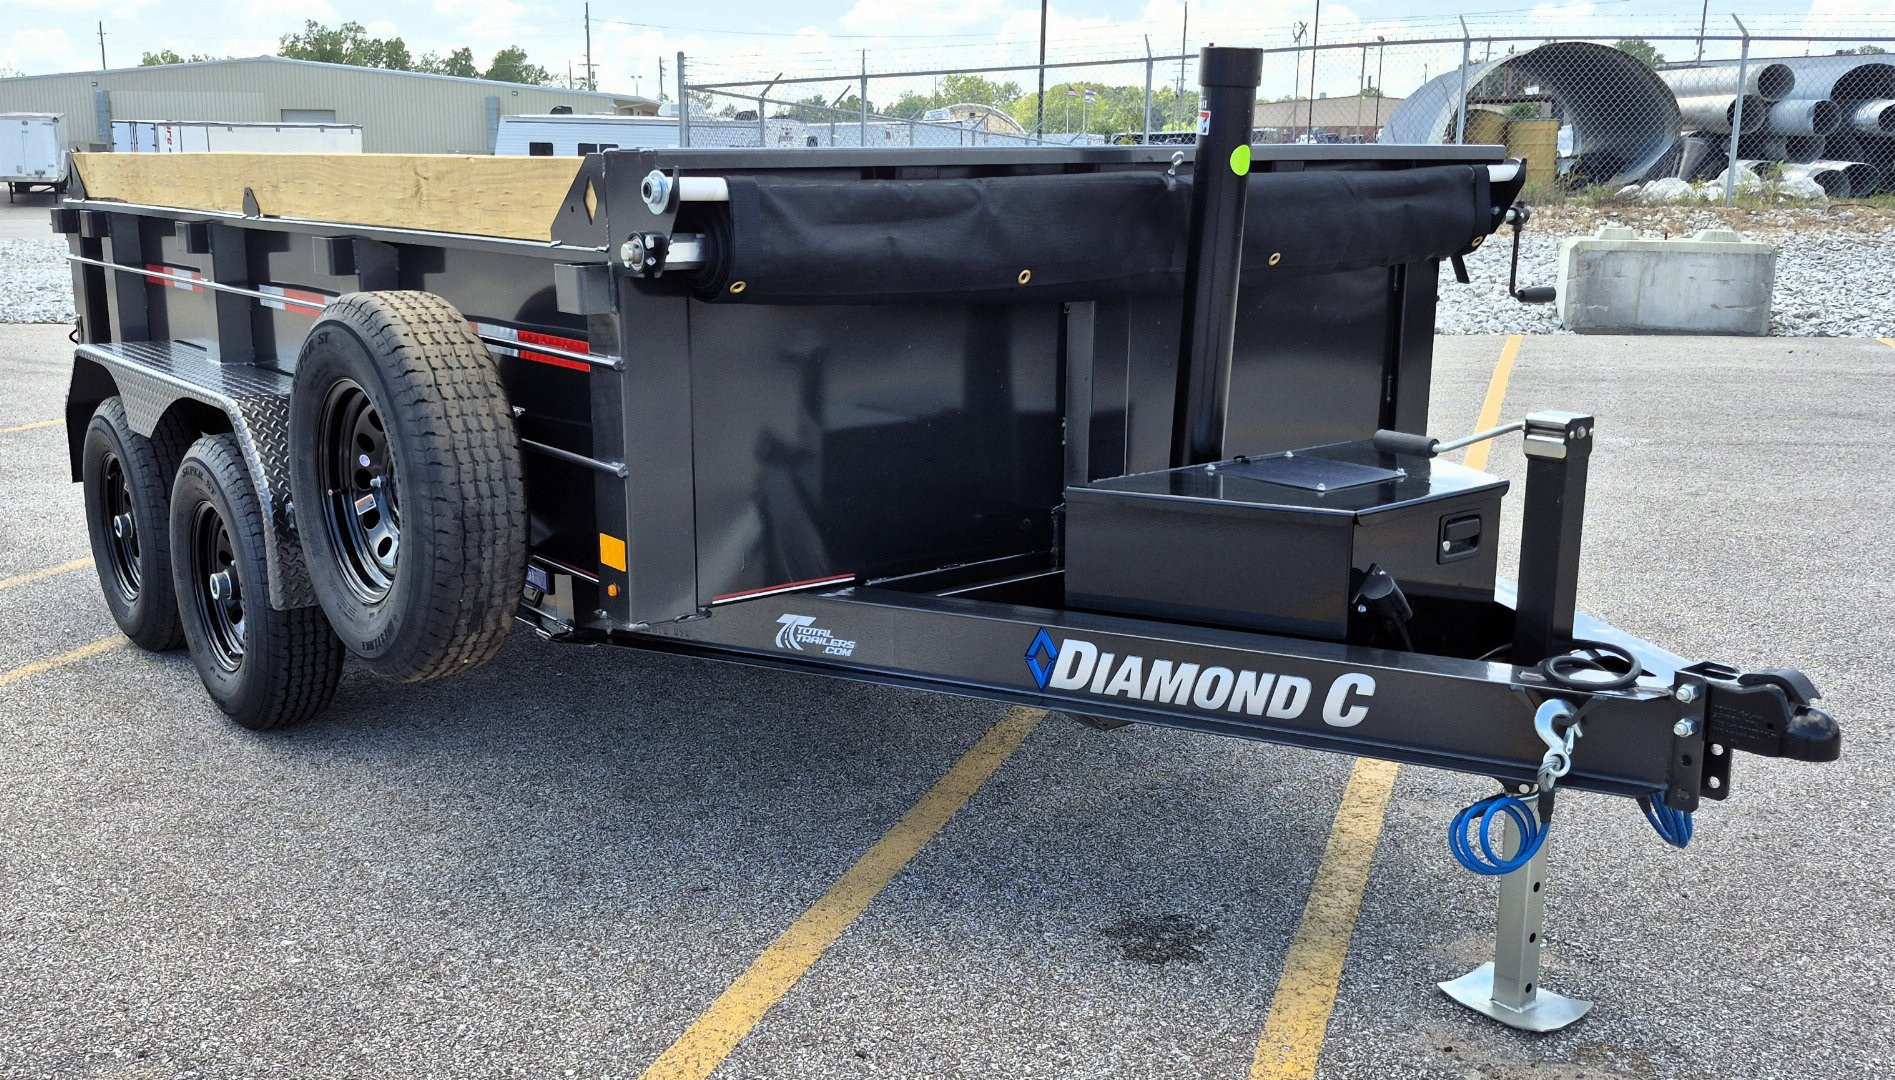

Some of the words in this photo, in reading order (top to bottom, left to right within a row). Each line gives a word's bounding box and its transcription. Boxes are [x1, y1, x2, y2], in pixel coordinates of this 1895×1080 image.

[797, 626, 834, 638] TOTAL
[796, 634, 856, 649] TRAILERS
[822, 646, 853, 657] .COM
[1048, 638, 1312, 720] DIAMOND
[1322, 672, 1376, 728] C
